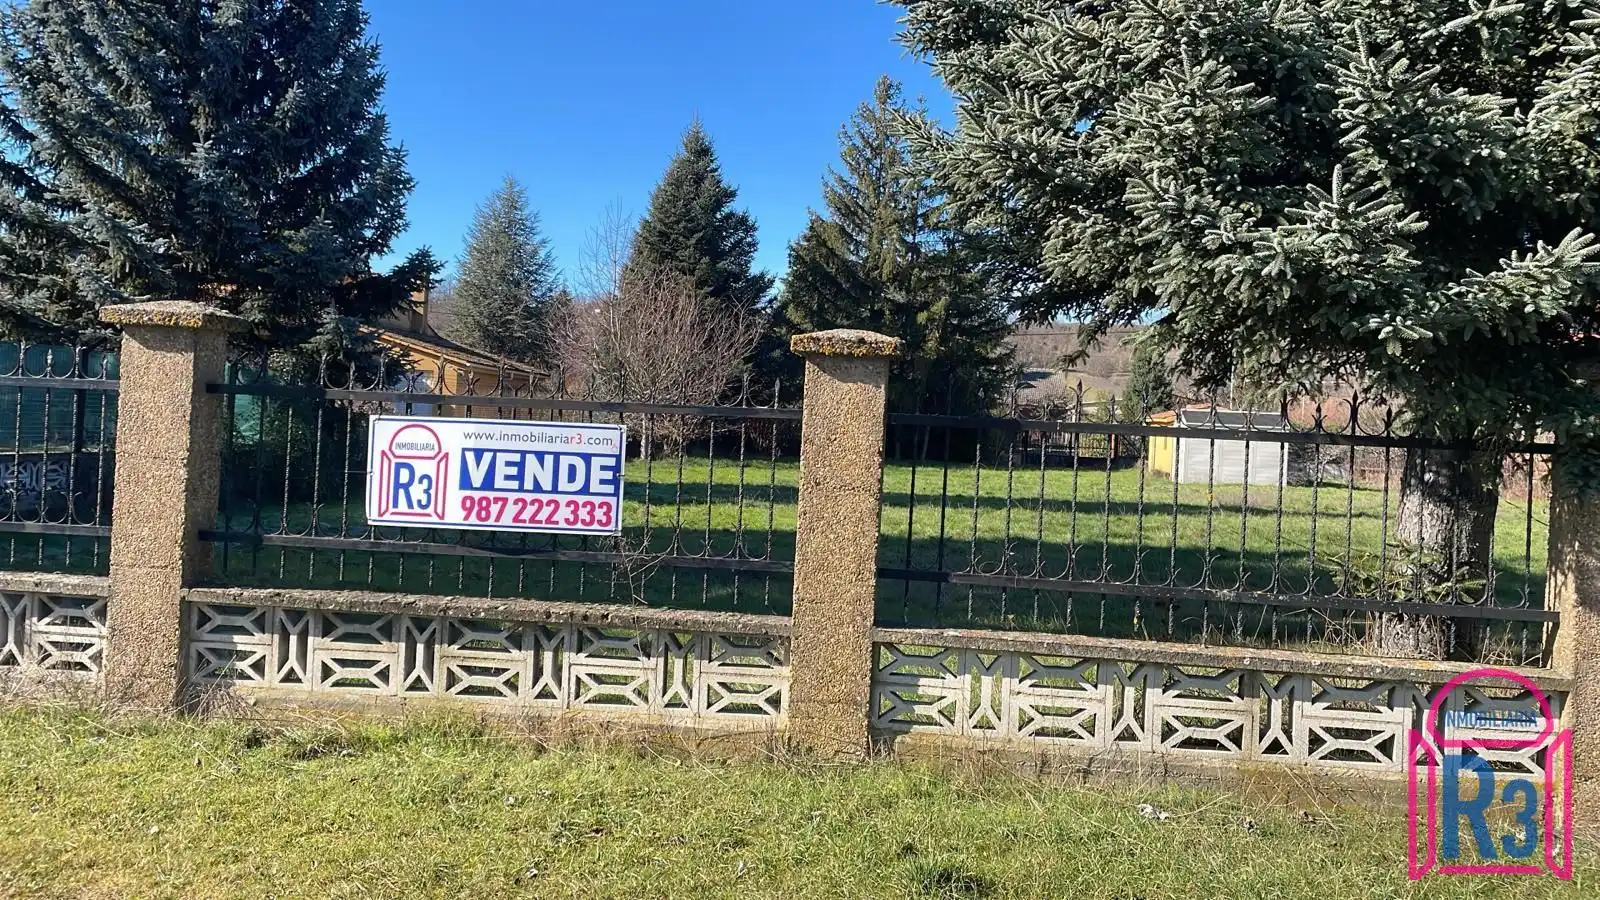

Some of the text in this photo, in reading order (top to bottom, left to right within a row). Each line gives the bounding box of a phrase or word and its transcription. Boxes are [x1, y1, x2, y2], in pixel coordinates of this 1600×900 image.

[395, 441, 436, 452] INMOBILIARIA
[463, 430, 613, 446] www.inmobiliariar3.com
[392, 461, 433, 510] R3
[464, 450, 616, 493] VENDE
[461, 495, 613, 528] 987 222 333
